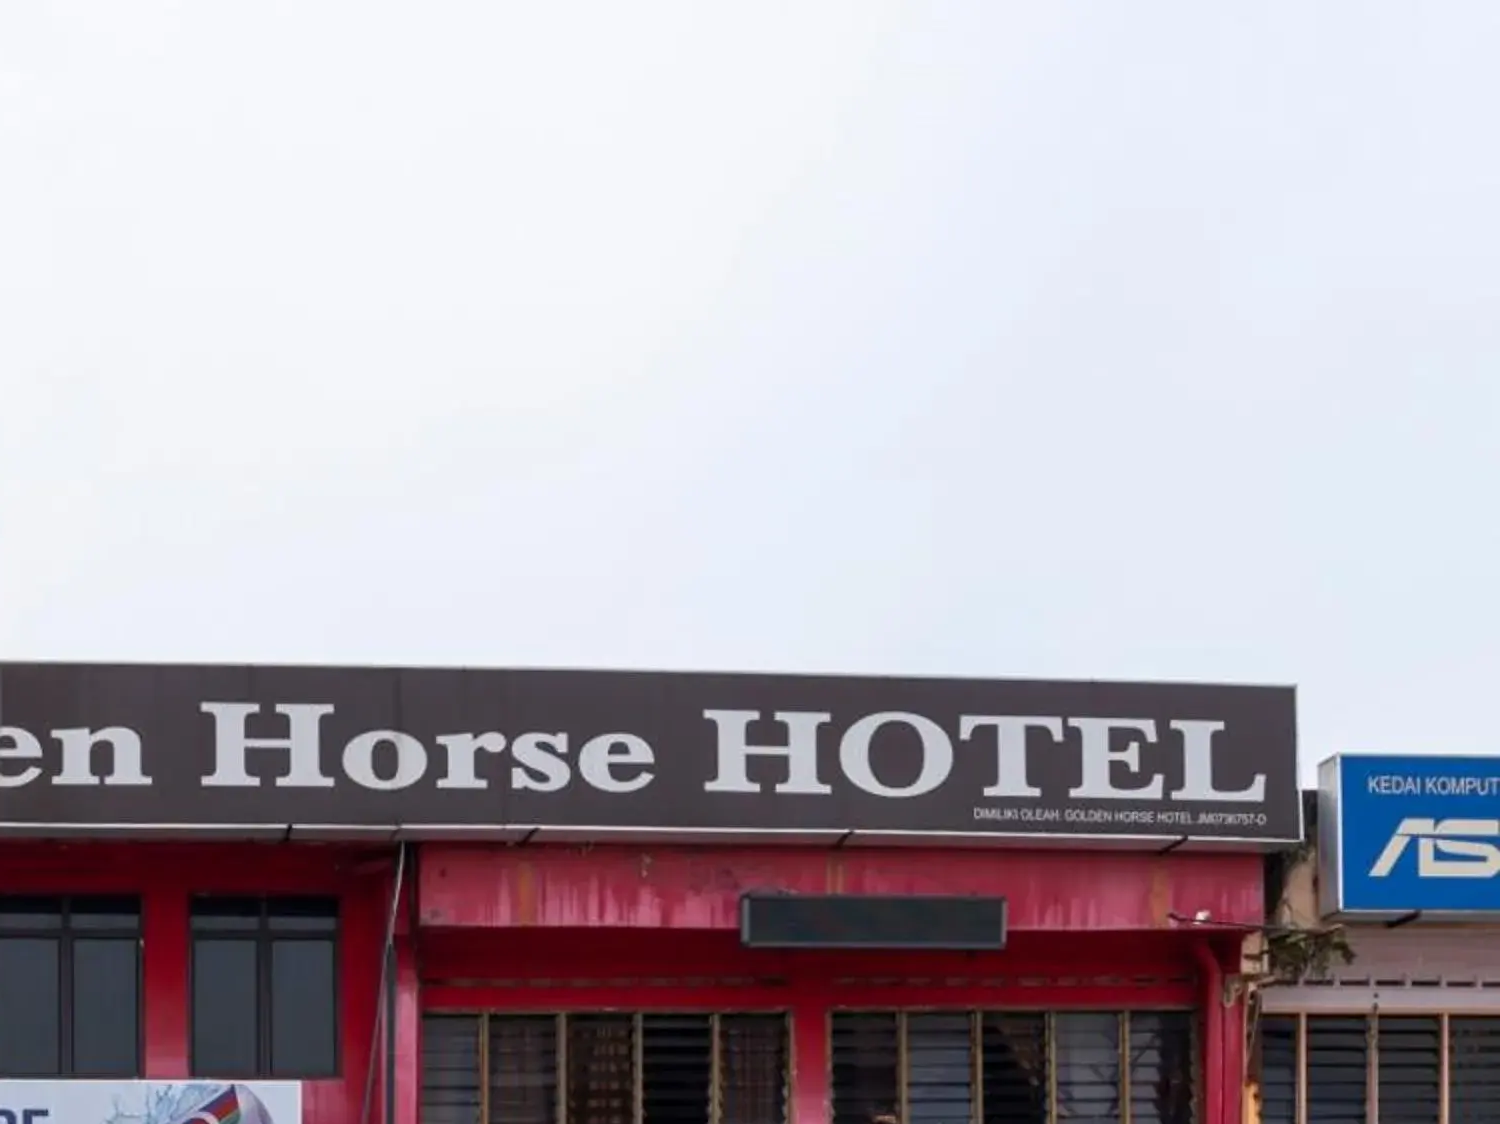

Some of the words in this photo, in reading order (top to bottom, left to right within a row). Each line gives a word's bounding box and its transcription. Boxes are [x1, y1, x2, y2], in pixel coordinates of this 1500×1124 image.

[200, 700, 656, 794] Horse
[702, 707, 1267, 803] HOTEL
[1367, 775, 1421, 794] KEDAI
[1425, 777, 1500, 797] KOMPUT
[1064, 808, 1113, 823] GOLDEN
[1114, 810, 1155, 824] HORSE
[1157, 811, 1195, 825] HOTEL
